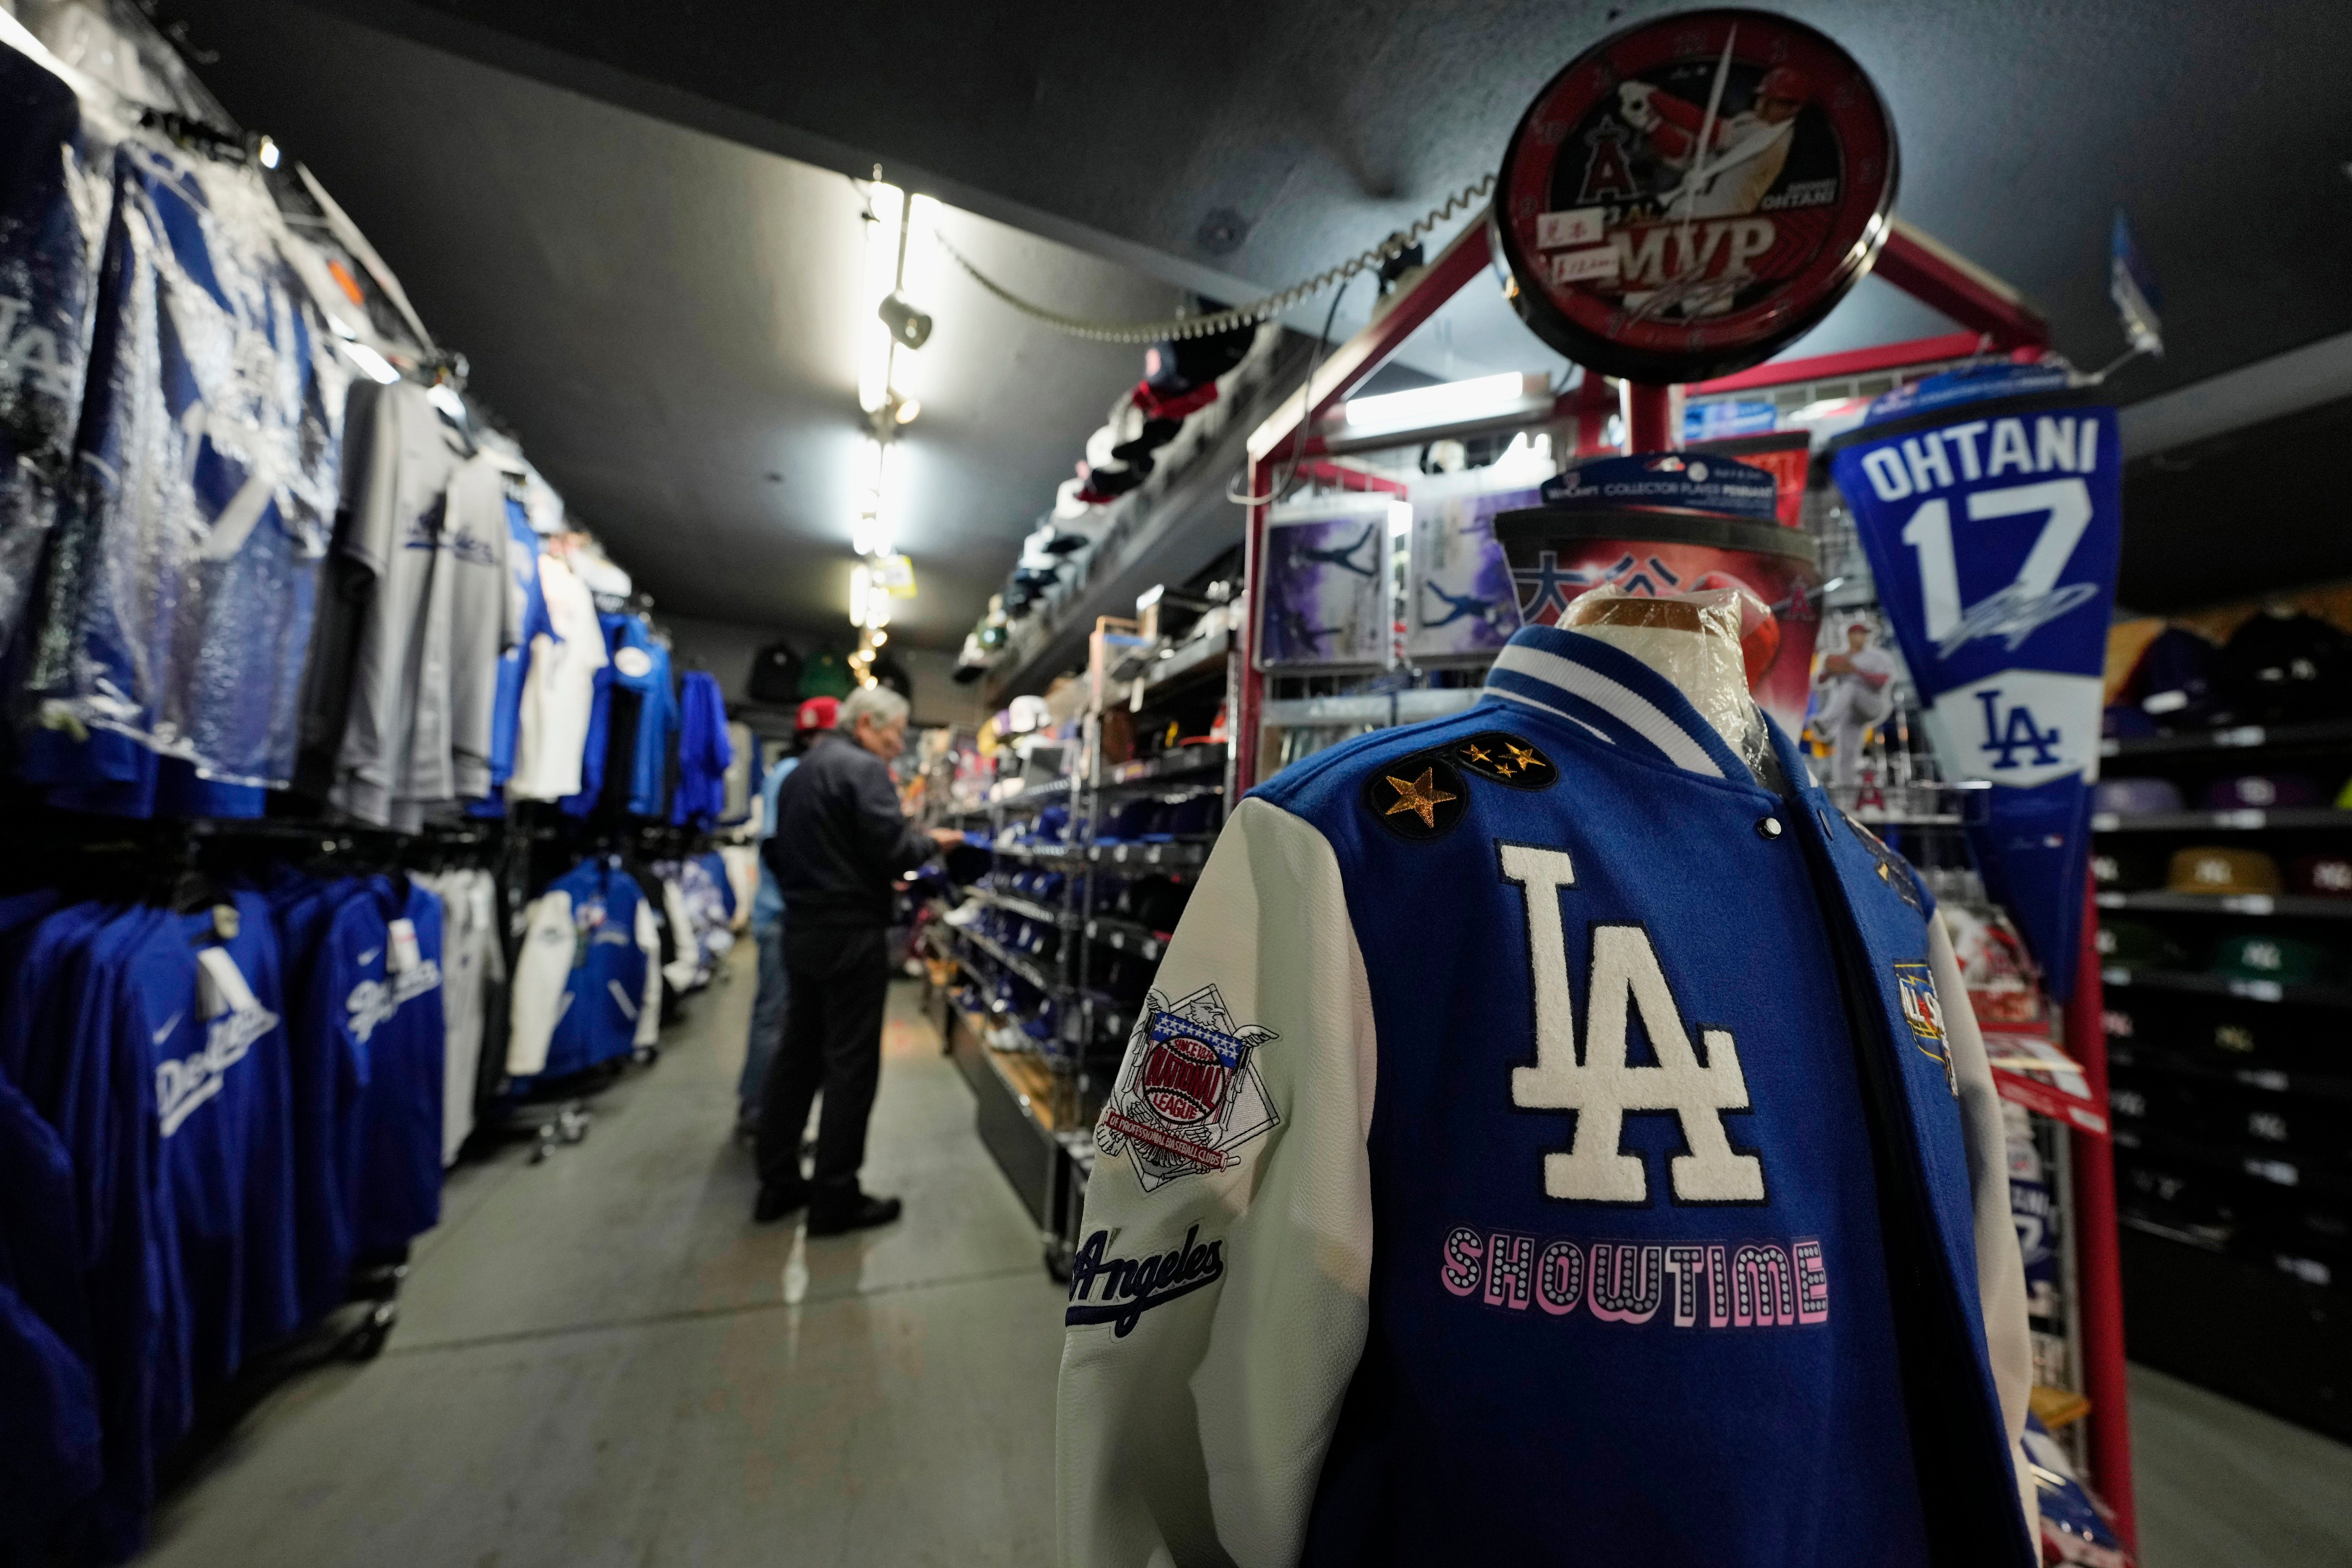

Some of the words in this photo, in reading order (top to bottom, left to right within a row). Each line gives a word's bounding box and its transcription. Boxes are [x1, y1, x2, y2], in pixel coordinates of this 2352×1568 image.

[1597, 216, 1776, 288] MVP
[1861, 416, 2100, 503] OHTANI
[1901, 477, 2094, 644] 17
[1975, 690, 2060, 769] LA
[1498, 842, 1767, 1205] LA
[1145, 1045, 1221, 1110] NATIONAL
[1153, 1093, 1199, 1120] LEAGUE
[1109, 1116, 1119, 1126] OF
[1118, 1118, 1166, 1147] PROFESSIONAL
[1165, 1137, 1198, 1158] BASEBALL
[1198, 1150, 1221, 1165] CLUBS
[1066, 1224, 1224, 1338] Angeles
[1440, 1226, 1829, 1328] SHOWTIME
